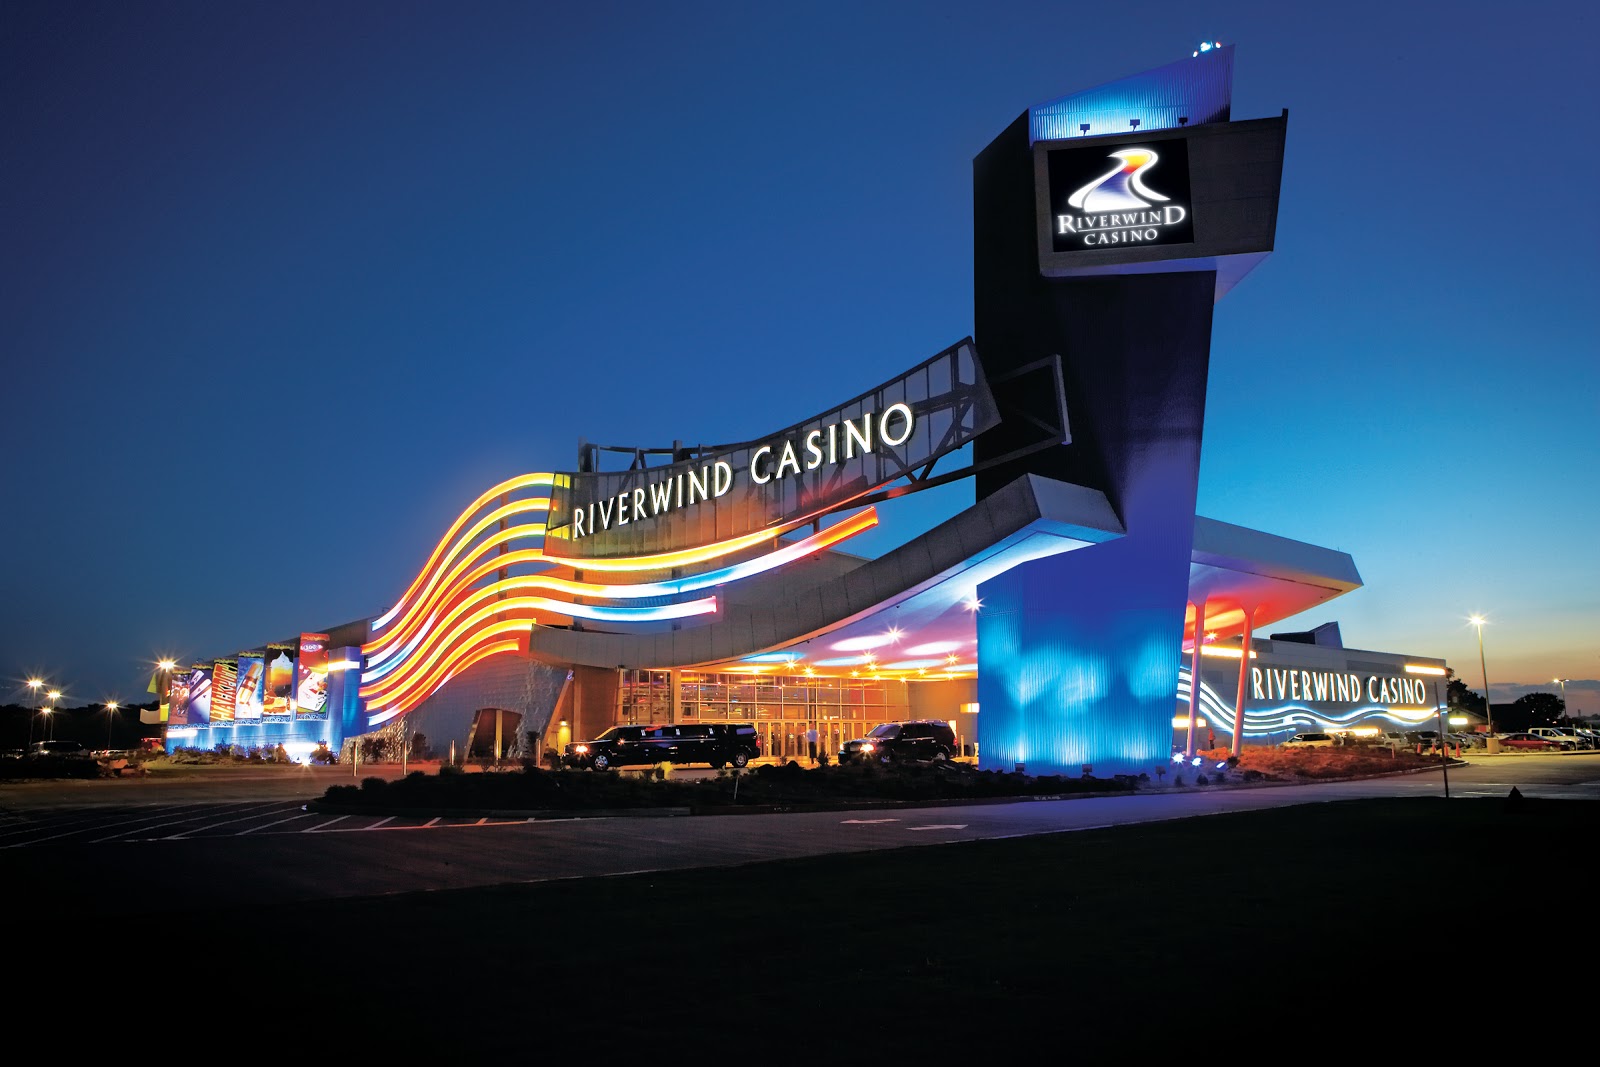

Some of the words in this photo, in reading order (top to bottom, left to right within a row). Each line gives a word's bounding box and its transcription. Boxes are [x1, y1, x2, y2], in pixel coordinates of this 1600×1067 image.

[1058, 206, 1186, 234] RIVERWIND
[1084, 228, 1158, 245] CASINO
[573, 461, 733, 540] RIVERWIND
[751, 403, 914, 485] CASINO
[1252, 667, 1361, 703] RIVERWIND
[1367, 676, 1426, 704] CASINO
